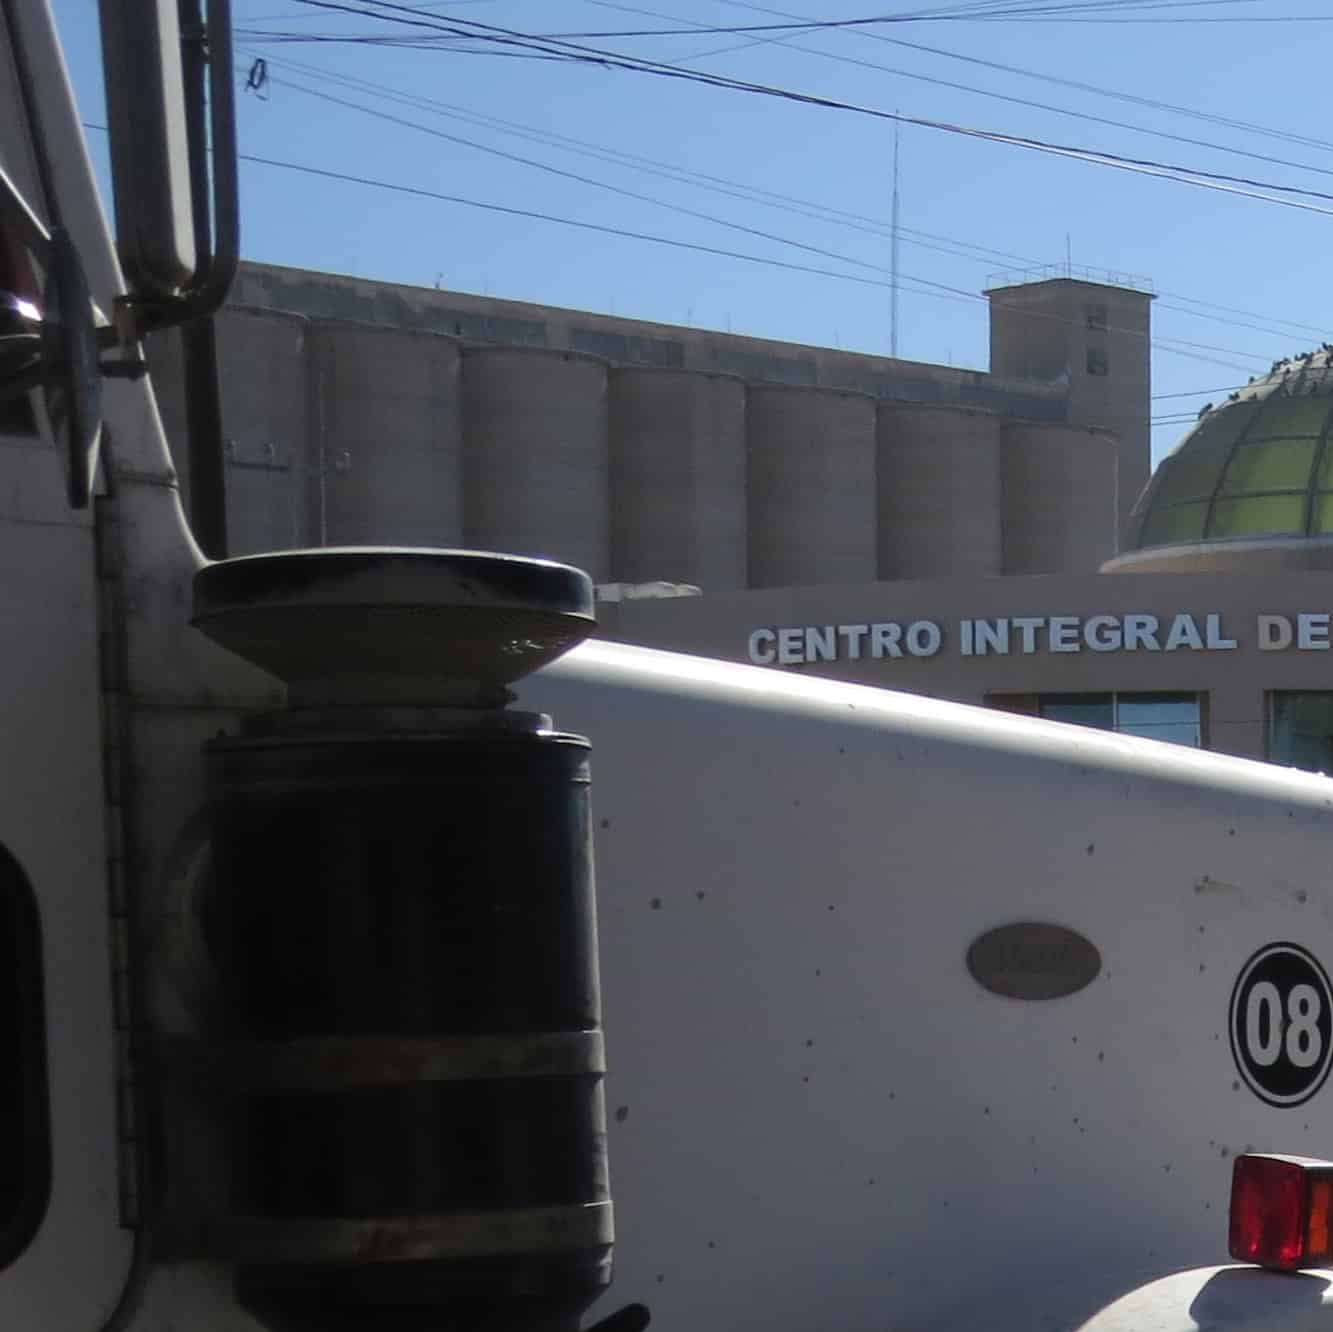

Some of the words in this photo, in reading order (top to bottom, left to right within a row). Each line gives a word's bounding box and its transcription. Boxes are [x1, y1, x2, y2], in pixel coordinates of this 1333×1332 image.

[747, 619, 941, 665] CENTRO
[960, 612, 1239, 656] INTEGRAL
[1256, 613, 1331, 652] DE
[1245, 980, 1322, 1068] 08
